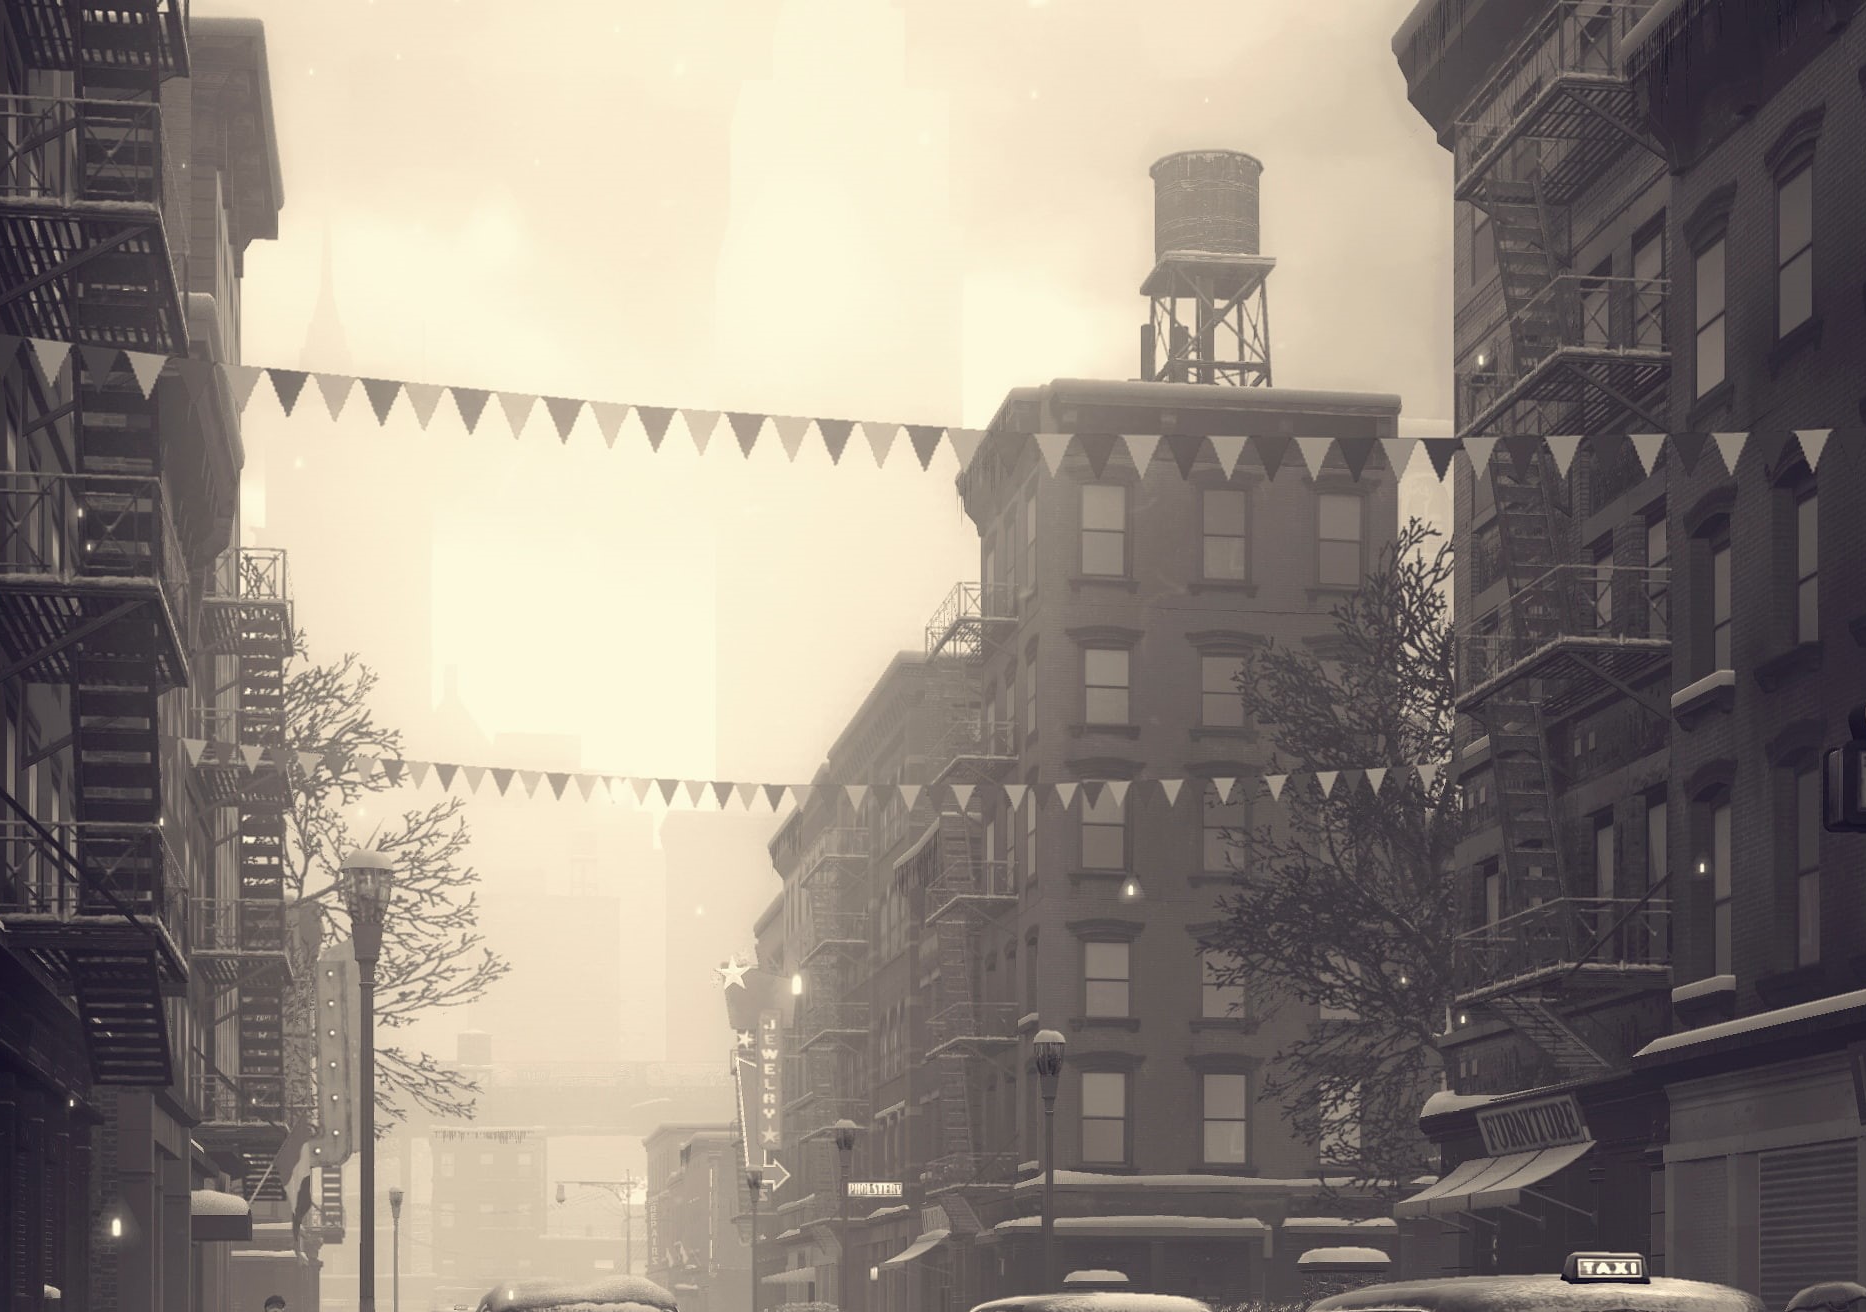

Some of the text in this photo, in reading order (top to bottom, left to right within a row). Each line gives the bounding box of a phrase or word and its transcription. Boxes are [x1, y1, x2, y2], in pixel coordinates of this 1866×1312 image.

[761, 1018, 779, 1121] JEWELRY
[1481, 1100, 1581, 1151] FURNITURE
[848, 1183, 902, 1196] PHOLSTERY
[1582, 1261, 1638, 1276] TAXI
